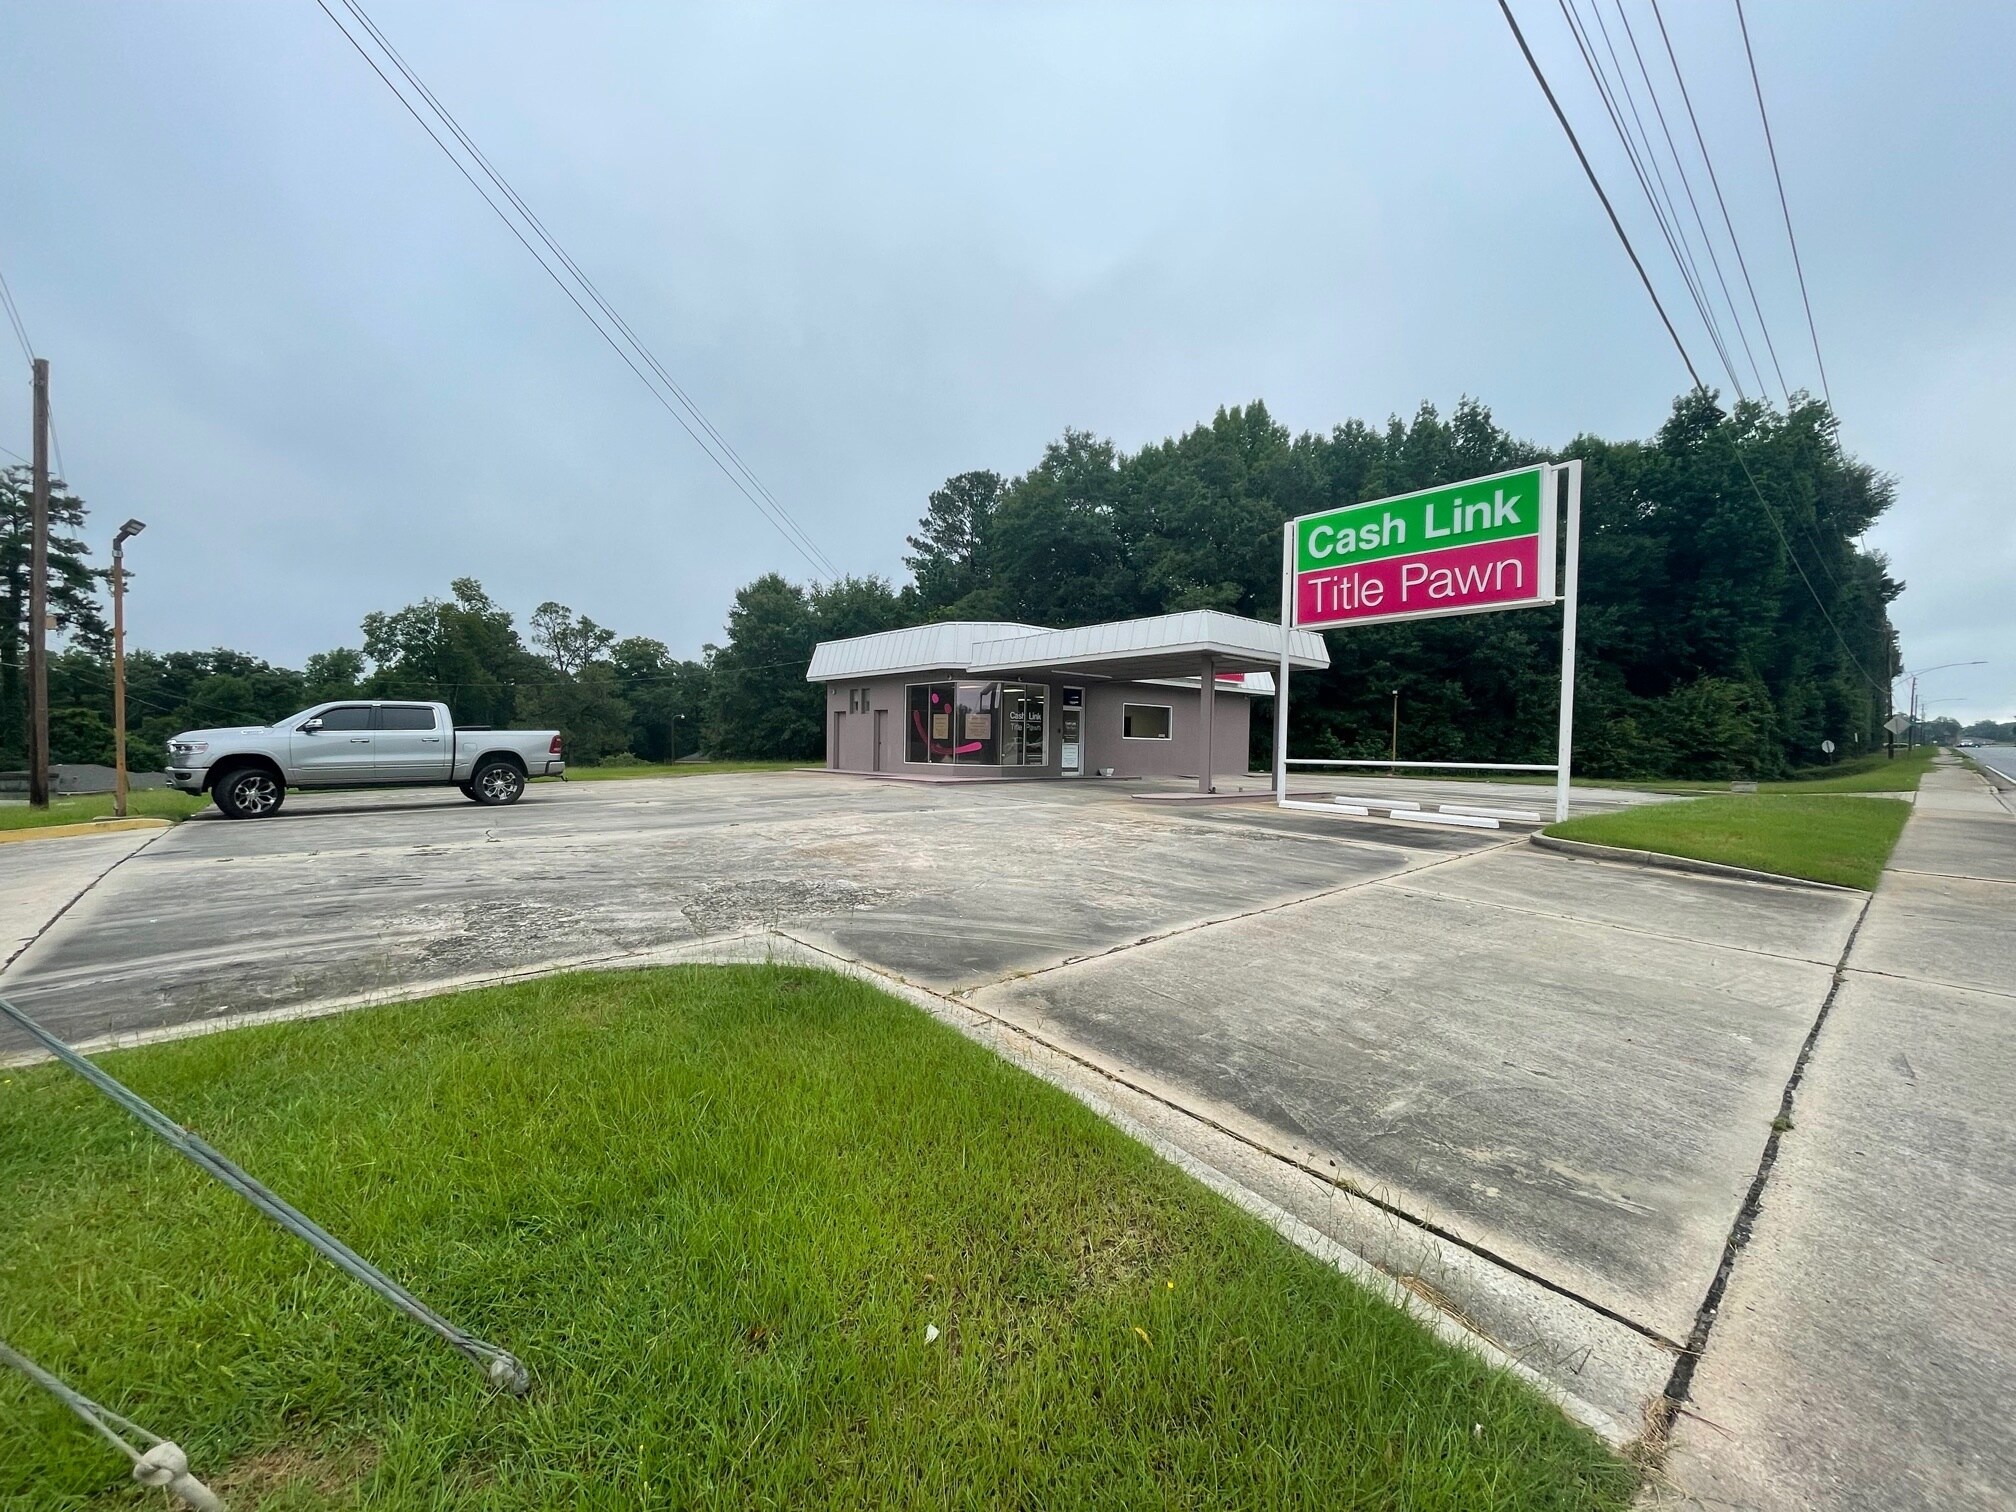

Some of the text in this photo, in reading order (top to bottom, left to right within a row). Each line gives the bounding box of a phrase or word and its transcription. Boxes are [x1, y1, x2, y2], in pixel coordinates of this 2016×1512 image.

[1308, 489, 1523, 559] Cash Link
[1308, 558, 1523, 613] Title Pawn
[1028, 712, 1042, 720] Link
